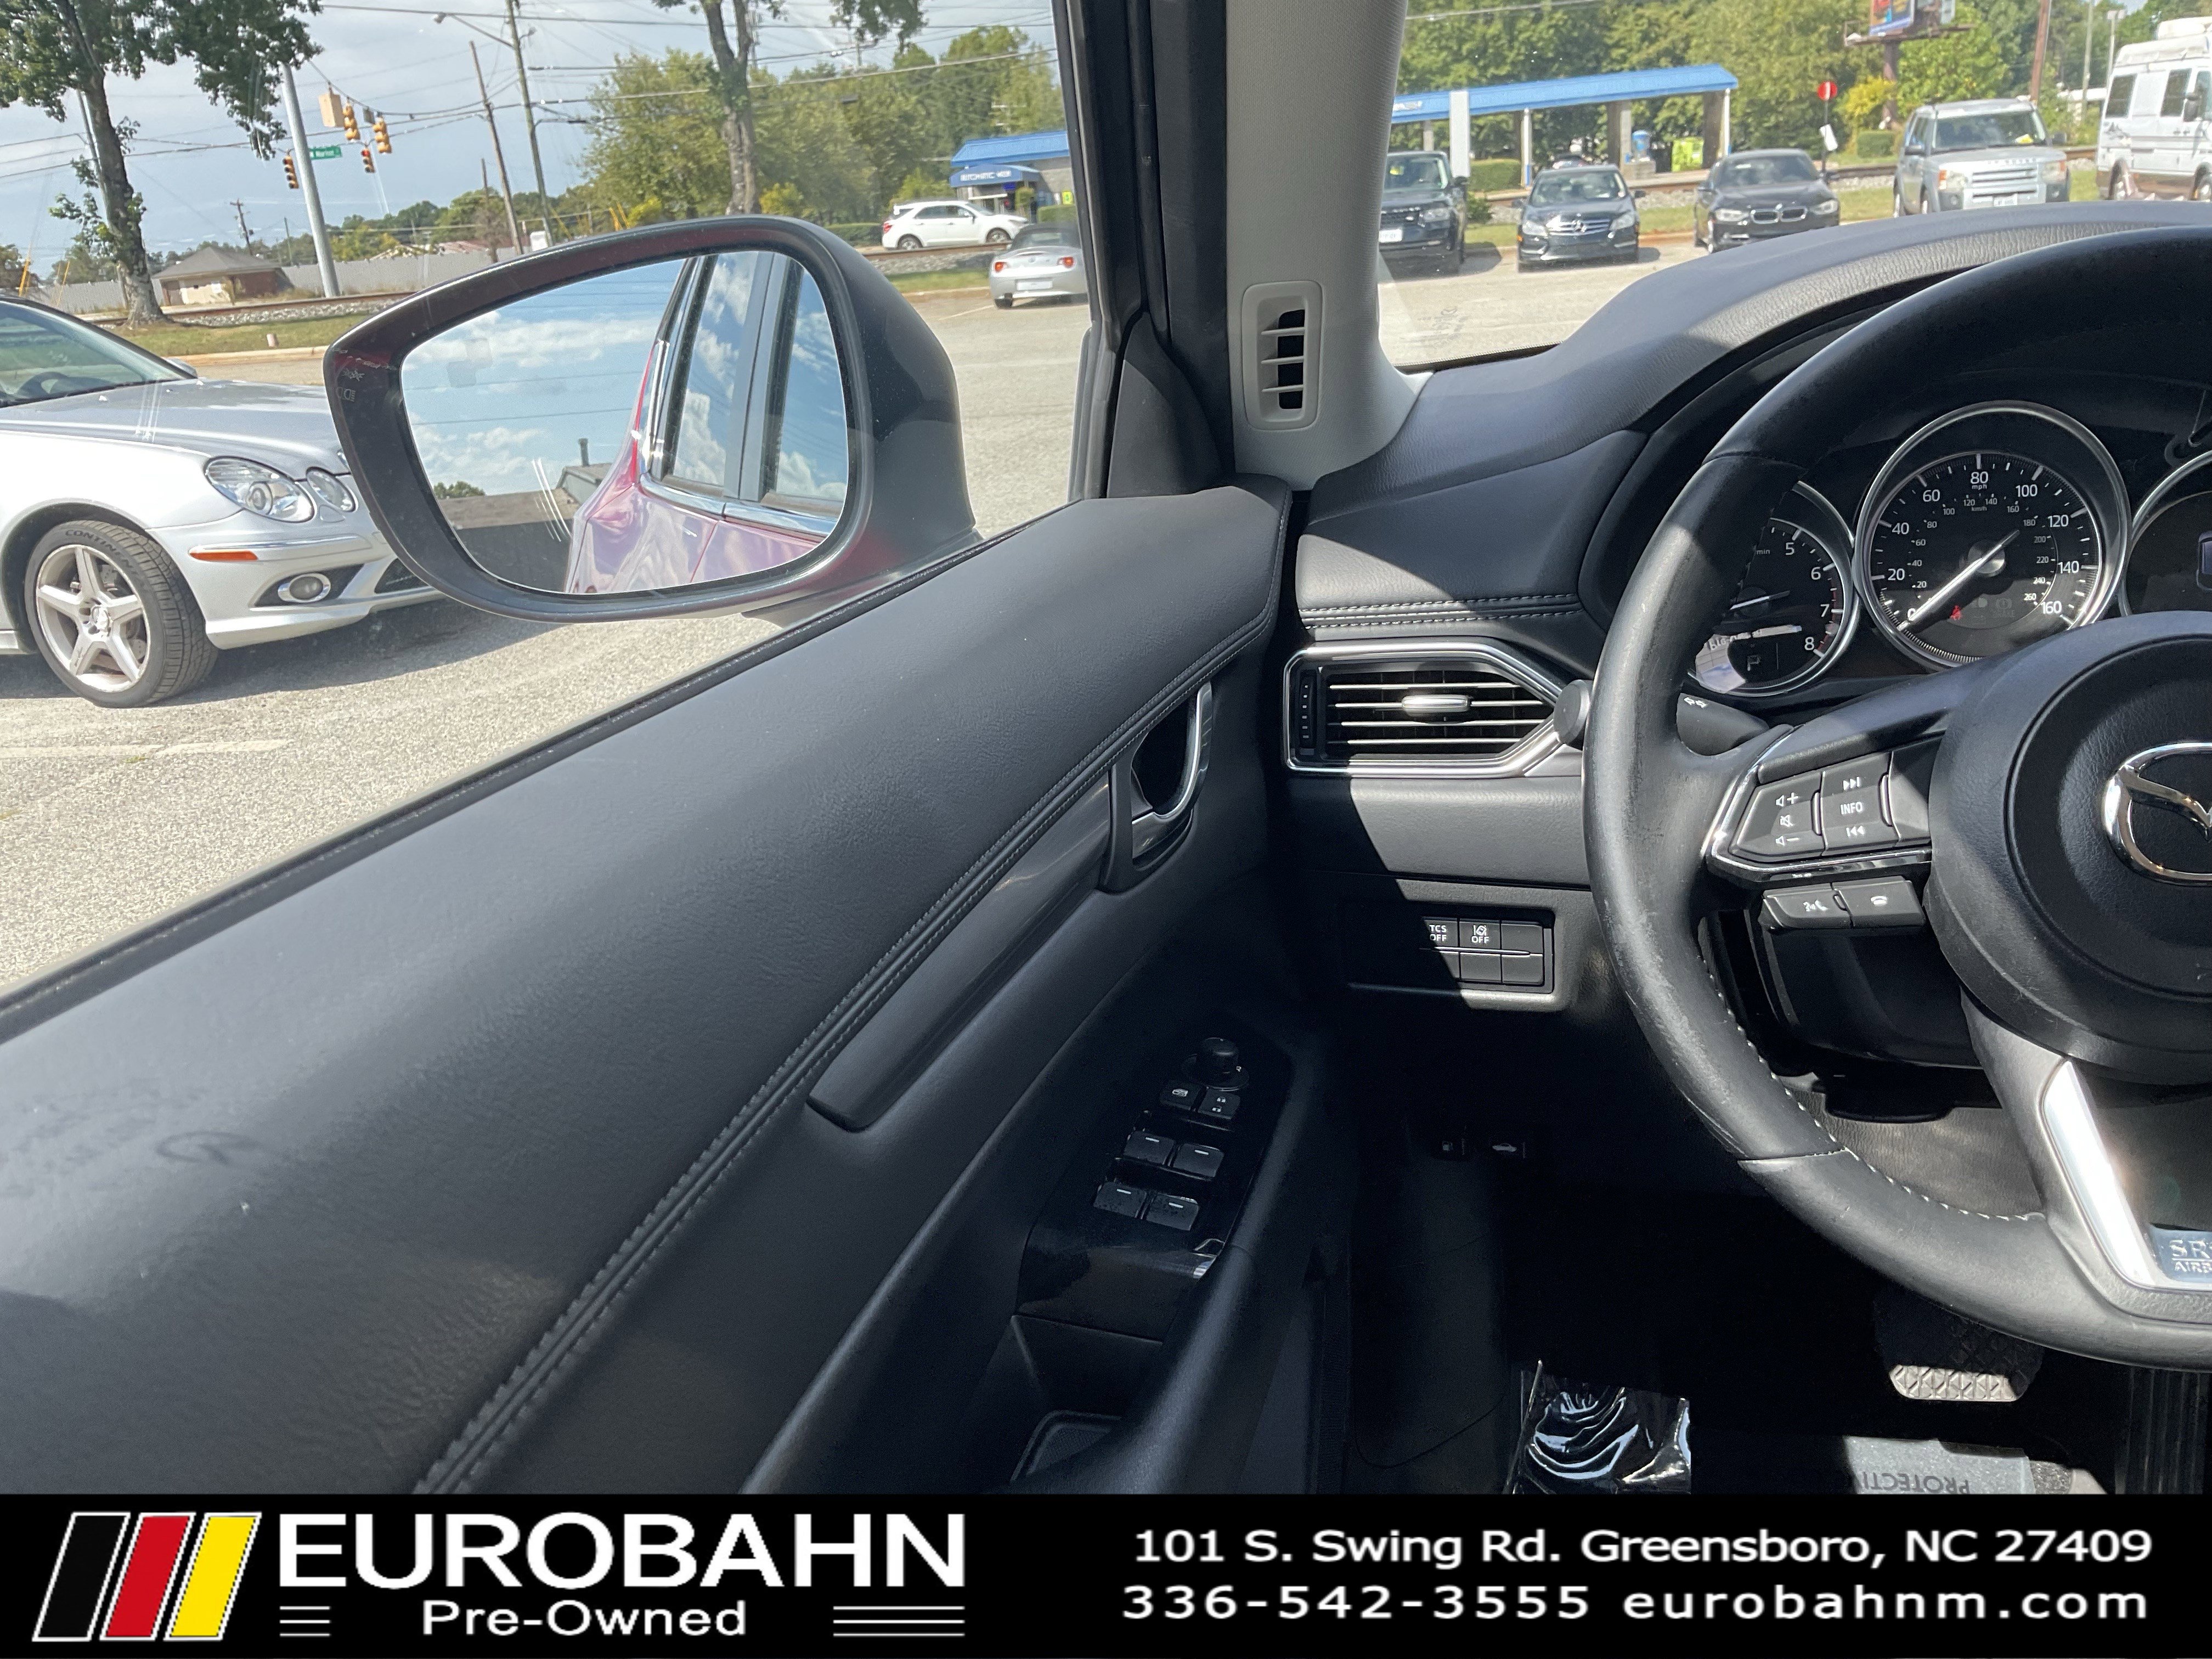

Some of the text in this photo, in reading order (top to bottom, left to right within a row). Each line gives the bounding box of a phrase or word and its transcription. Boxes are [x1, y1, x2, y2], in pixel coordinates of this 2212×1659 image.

[1970, 471, 1989, 484] 80
[1922, 489, 1940, 502] 60
[2016, 484, 2038, 498] 100
[2047, 514, 2069, 528] 120
[1892, 522, 1910, 535] 40
[1785, 542, 1795, 555] 5
[1811, 567, 1821, 580] 6
[2058, 561, 2080, 574] 140
[1888, 568, 1905, 581] 20
[1820, 603, 1830, 618] 7
[2041, 601, 2062, 614] 160
[1804, 636, 1815, 651] 8
[1747, 654, 1761, 671] P
[1840, 800, 1863, 815] INFO
[1429, 924, 1447, 933] TCS
[1430, 933, 1447, 941] OFF
[2170, 1239, 2212, 1259] SR
